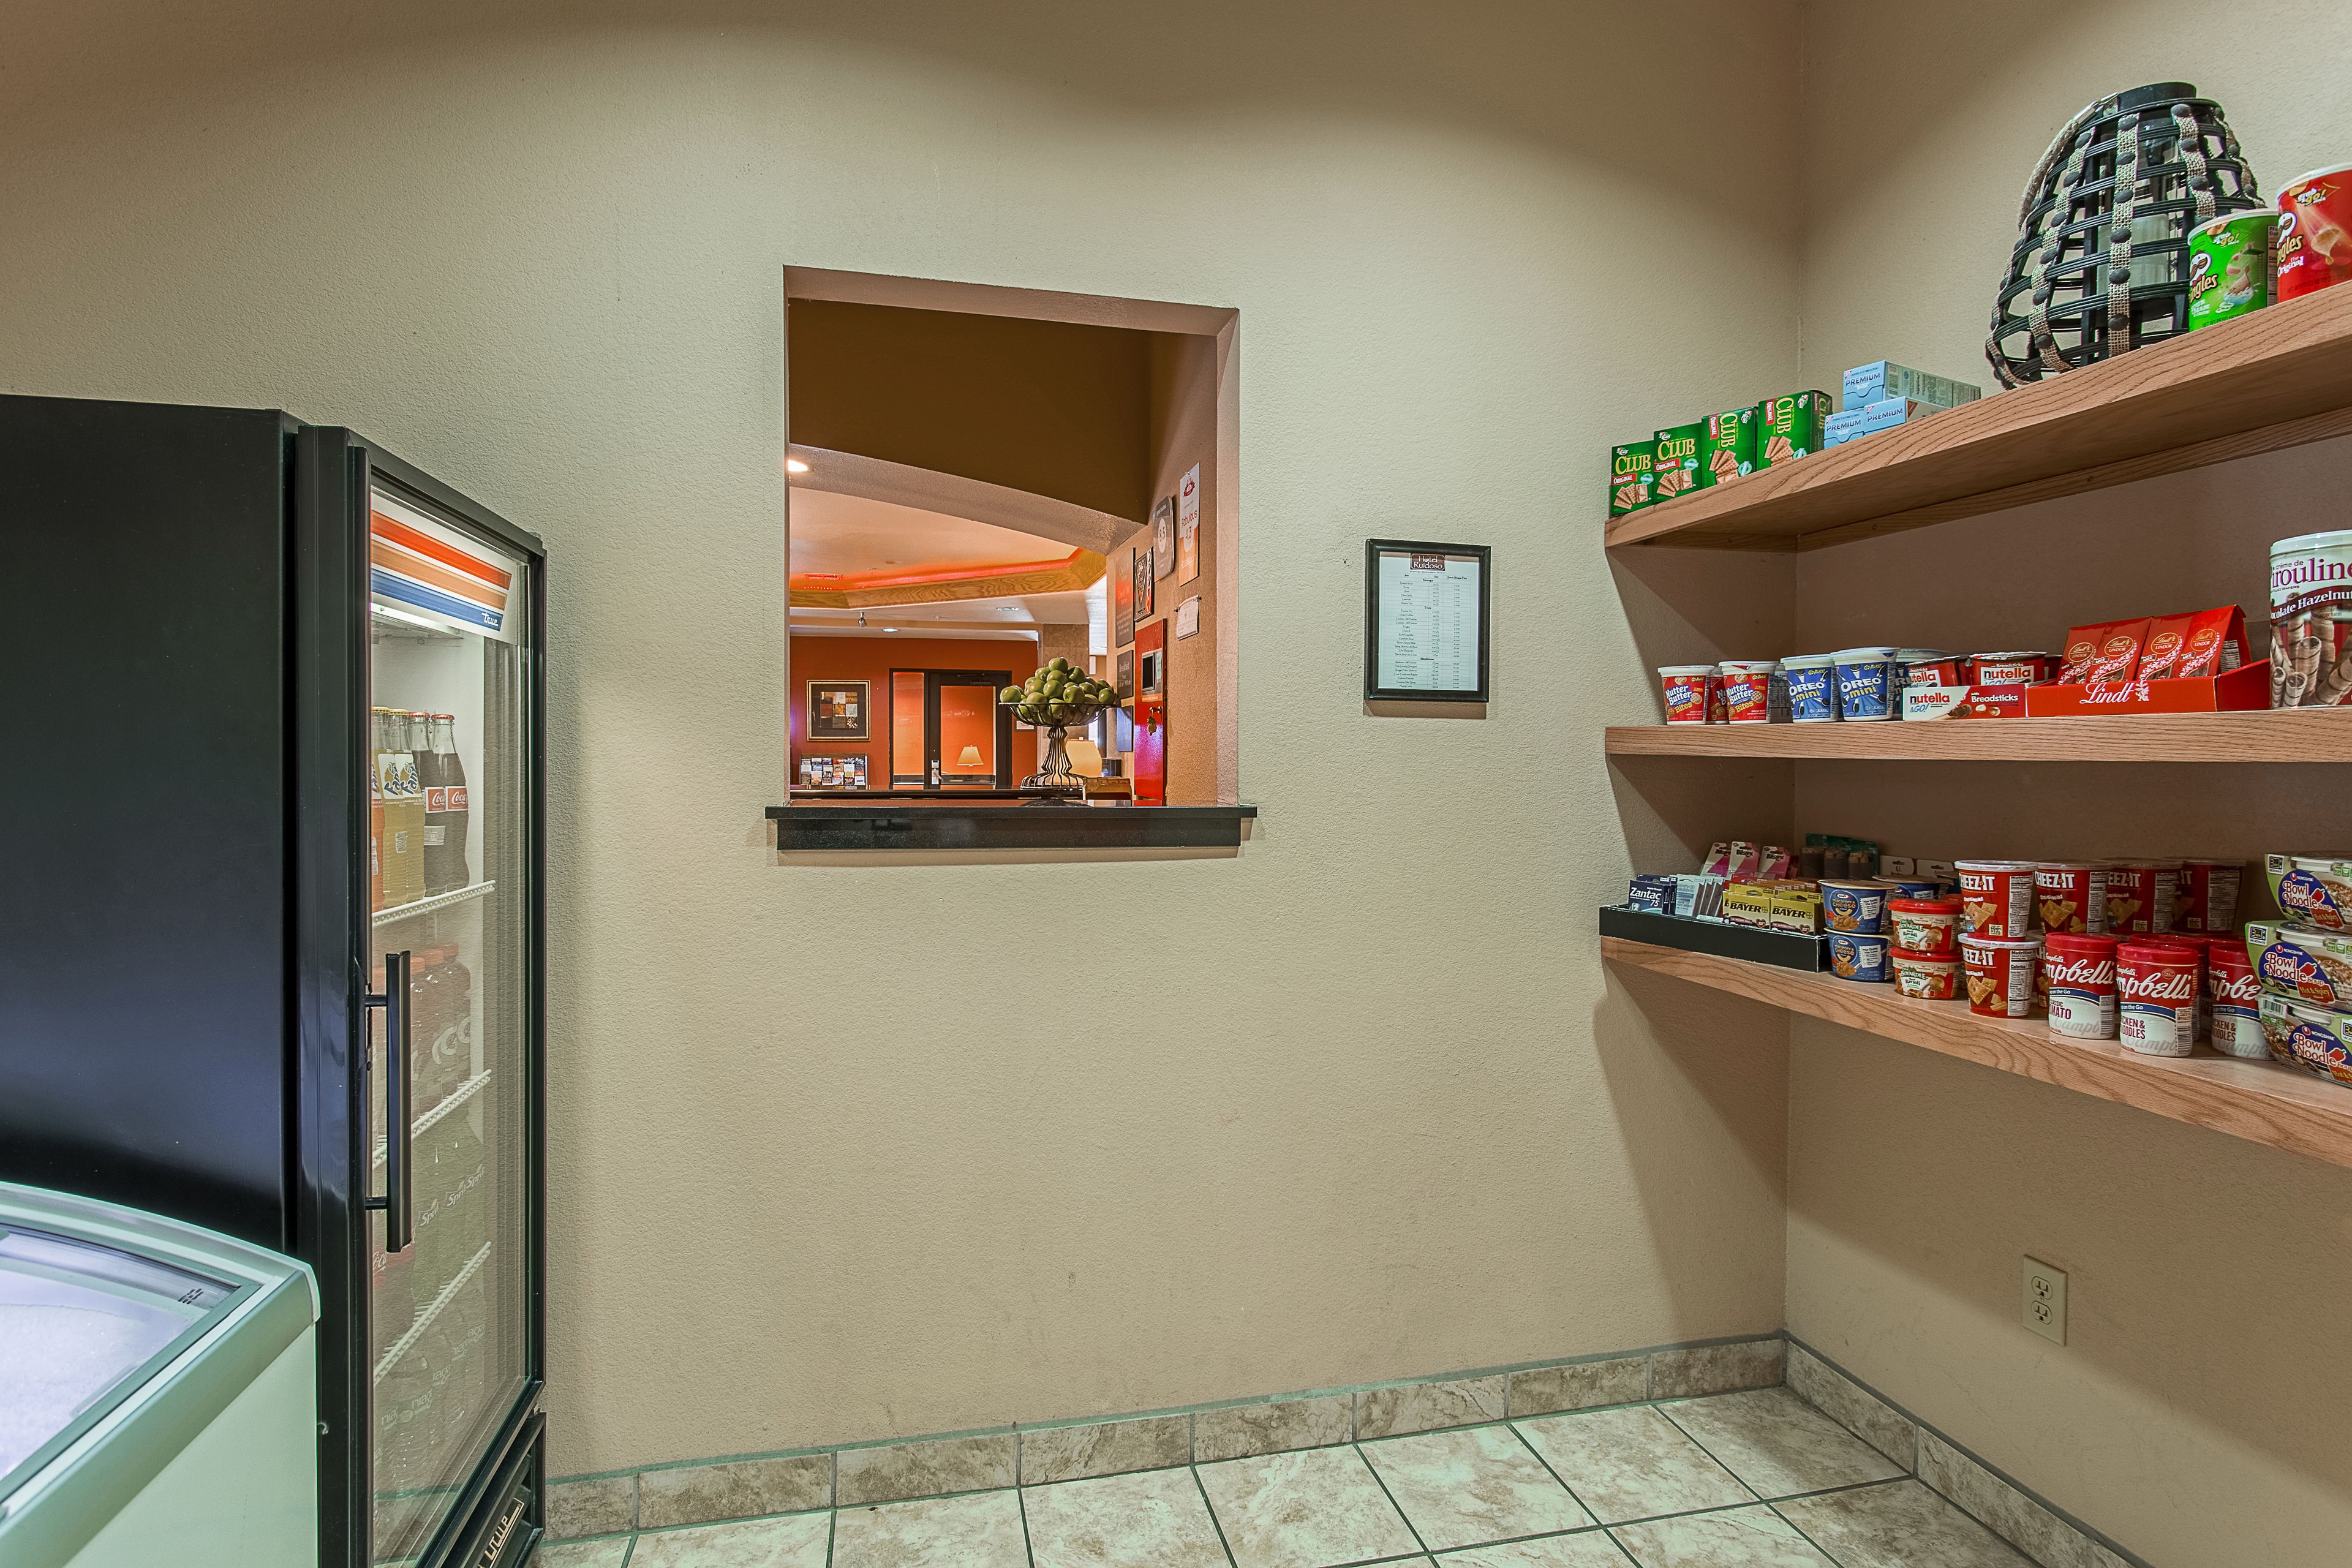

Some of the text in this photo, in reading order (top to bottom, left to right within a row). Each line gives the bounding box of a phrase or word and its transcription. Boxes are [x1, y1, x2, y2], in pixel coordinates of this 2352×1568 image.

[1845, 372, 1880, 386] PREMIUM
[1776, 397, 1795, 434] CLUB
[1867, 407, 1904, 422] PREMIUM
[1719, 412, 1738, 448] CLUB
[1826, 419, 1861, 432] PREMIUM
[1657, 438, 1695, 461] CLUB
[1615, 454, 1651, 475] CLUB
[1656, 461, 1676, 471] ORIGINAL
[1613, 475, 1633, 484] ORIGINAL
[1414, 561, 1442, 570] Ruidoso
[1983, 667, 2031, 679] nutella
[1665, 685, 1689, 699] Nutter
[1726, 683, 1750, 698] Nutter
[1789, 682, 1825, 696] OREO
[1841, 677, 1882, 693] OREO
[1849, 685, 1877, 698] mini
[1668, 691, 1693, 706] Butter
[1729, 690, 1754, 704] Butter
[1795, 689, 1821, 702] mini
[1909, 692, 1950, 704] nutella
[1971, 693, 2018, 703] Breadsticks
[2079, 682, 2135, 704] Lindt
[1674, 702, 1693, 713] Bites
[1736, 701, 1754, 713] Bites
[400, 765, 418, 794] Fant
[2108, 872, 2141, 888] EEZ-IT
[1629, 887, 1662, 900] Zantac
[2283, 881, 2309, 896] Bowl
[2283, 892, 2318, 909] Noodle
[1730, 903, 1762, 913] BAYER
[1772, 907, 1806, 918] BAYER
[2266, 952, 2297, 969] Bowl
[2264, 963, 2307, 982] Noodle
[2307, 977, 2324, 986] Soup
[2049, 1005, 2071, 1020] MATO
[2122, 1016, 2146, 1029] CKEN &
[2230, 1023, 2236, 1031] &
[2294, 1033, 2326, 1053] Bowl
[2293, 1044, 2337, 1066] Noodle
[466, 1167, 484, 1189] Spri
[447, 1185, 466, 1207] Spri
[420, 1201, 439, 1226] Spri
